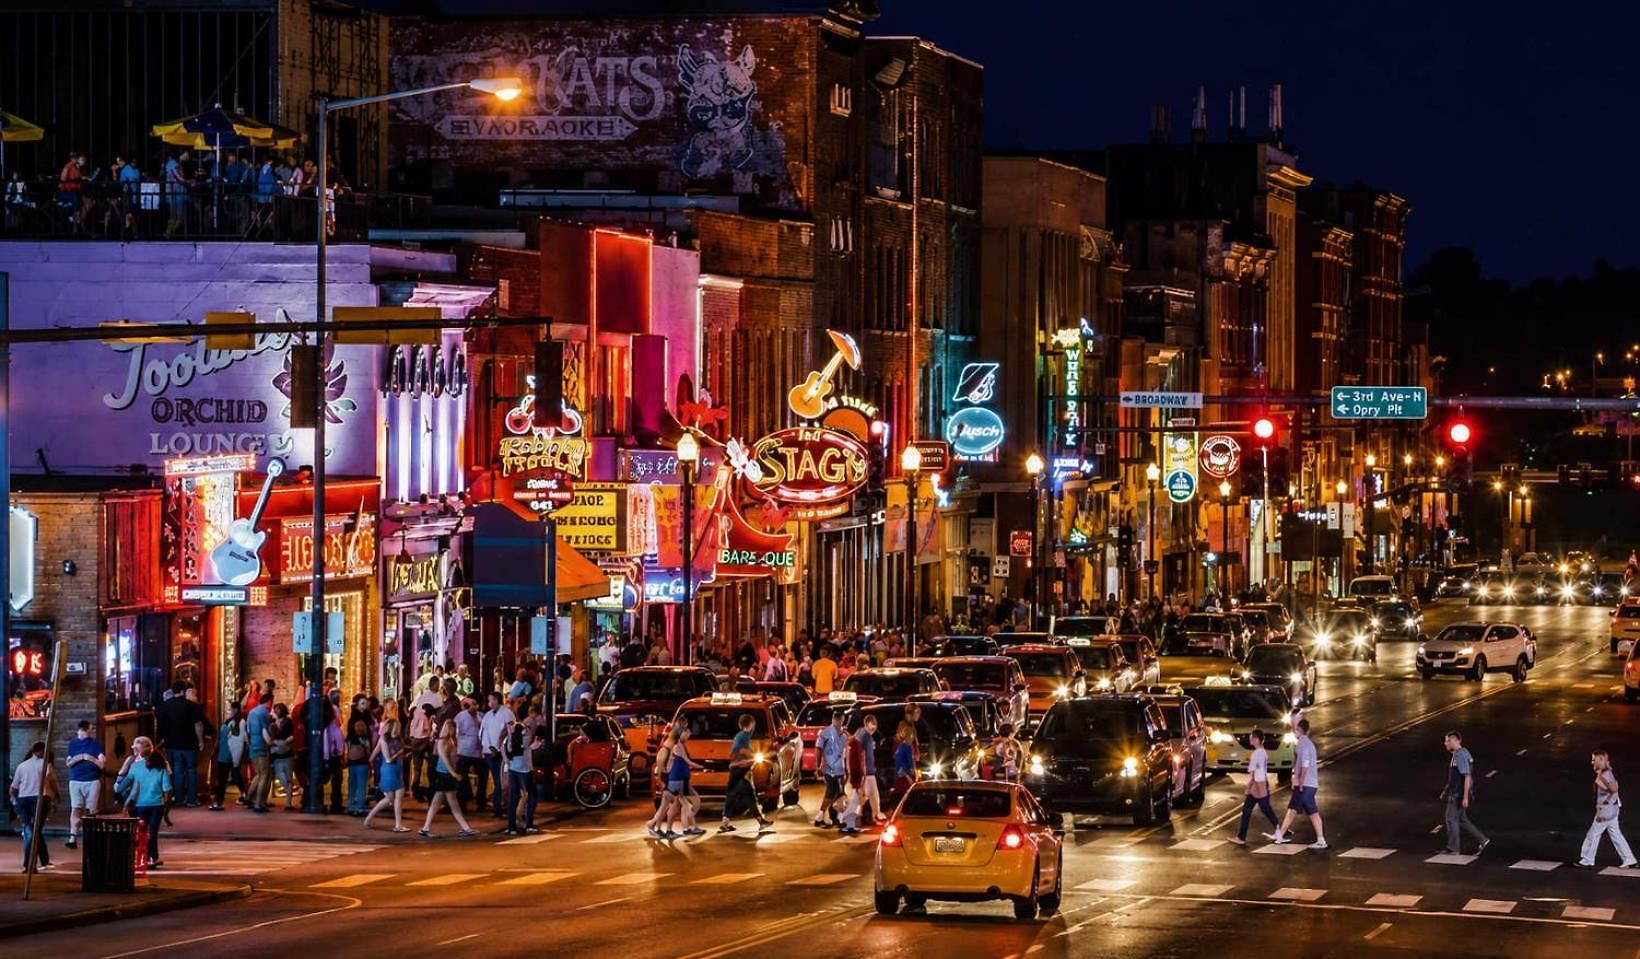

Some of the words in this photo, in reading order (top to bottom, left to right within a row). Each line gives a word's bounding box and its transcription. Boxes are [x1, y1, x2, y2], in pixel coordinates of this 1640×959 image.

[1135, 394, 1188, 405] BROADWAY
[1353, 391, 1374, 402] 3rd
[151, 397, 268, 426] ORCHID
[1353, 404, 1380, 416] Opry
